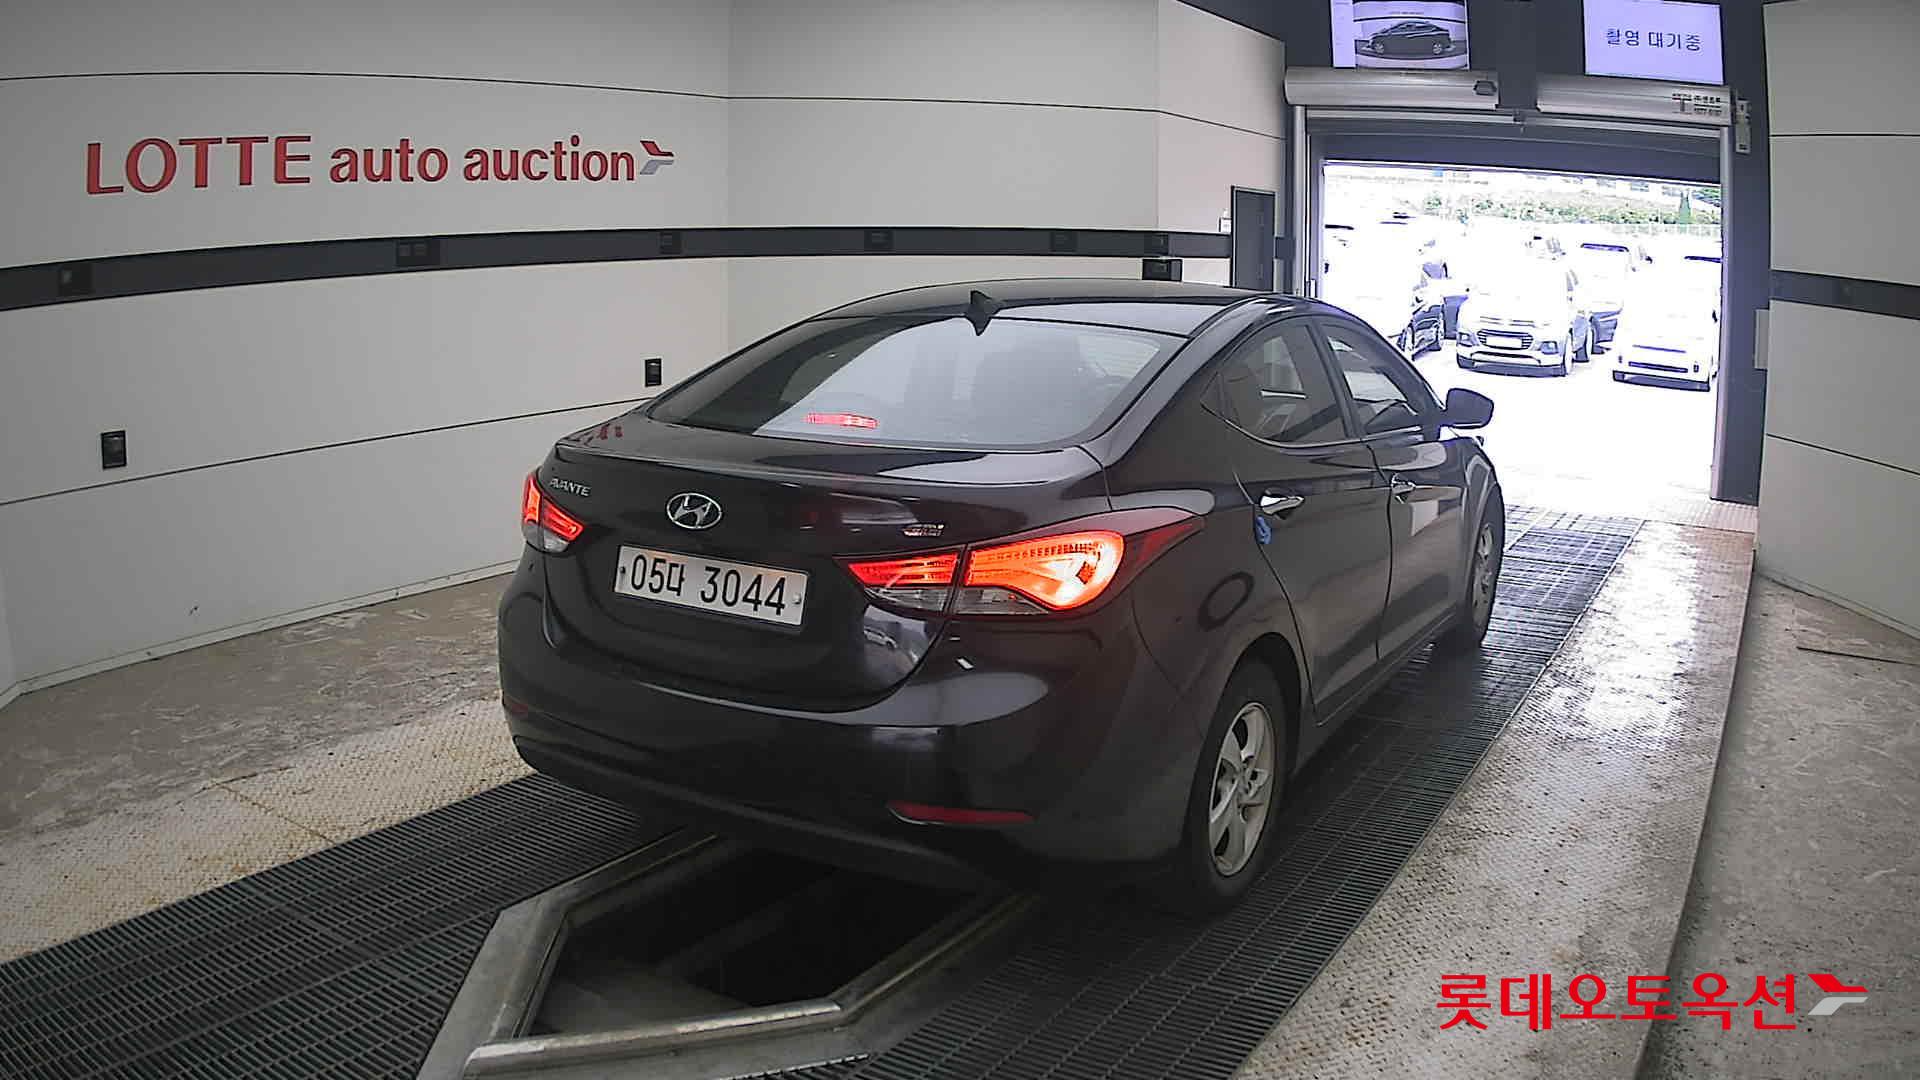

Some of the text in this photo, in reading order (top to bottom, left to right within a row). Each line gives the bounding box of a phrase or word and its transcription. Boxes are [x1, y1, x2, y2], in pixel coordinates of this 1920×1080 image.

[1648, 32, 1701, 51] 대기중
[87, 135, 635, 194] LOTTE auto auction
[550, 478, 591, 497] AVANTE
[631, 554, 786, 615] 05다 3044
